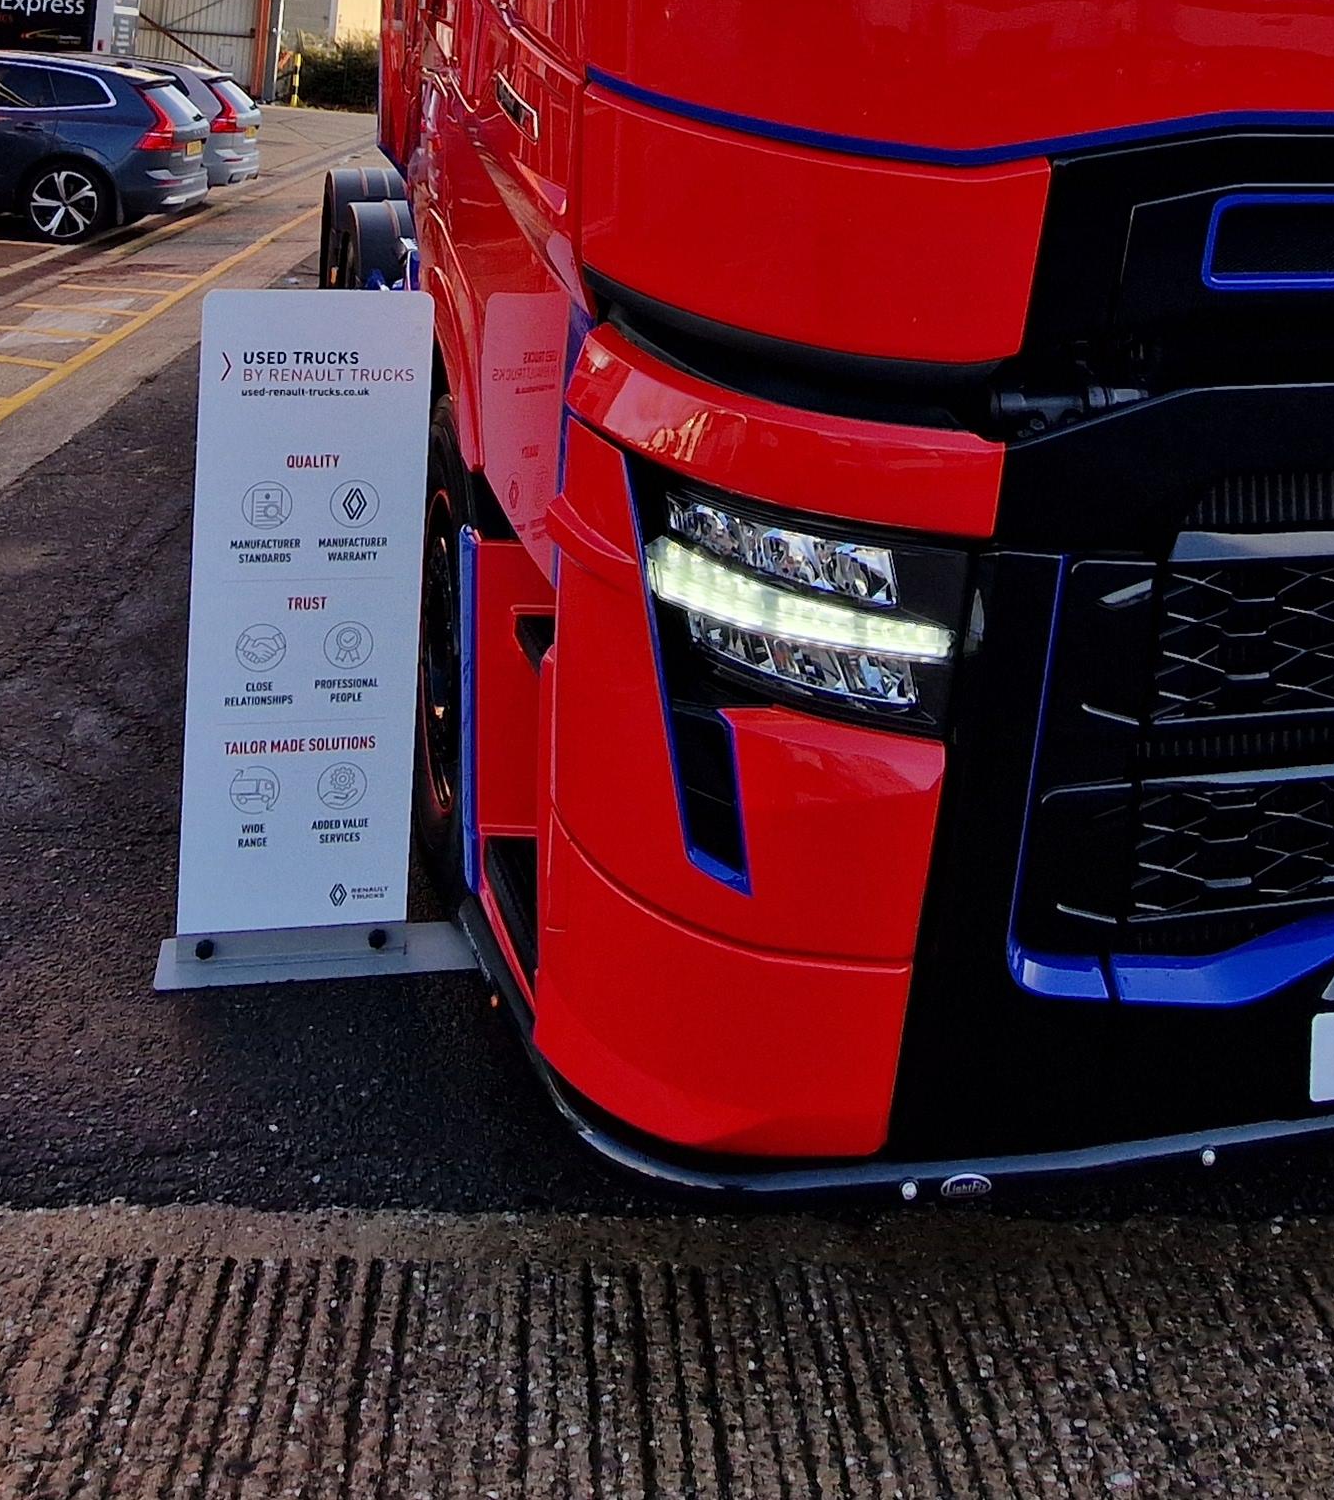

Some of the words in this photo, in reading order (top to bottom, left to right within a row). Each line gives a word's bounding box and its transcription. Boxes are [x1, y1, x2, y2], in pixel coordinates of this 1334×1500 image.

[243, 351, 287, 365] USED
[293, 351, 359, 365] TRUCKS
[243, 368, 264, 382] BY
[269, 368, 345, 382] RENAULT
[351, 368, 415, 382] TRUCKS
[241, 387, 370, 397] used-renault-trucks.co.uk
[286, 454, 340, 469] QUALITY
[230, 538, 301, 550] MANUFACTURER
[318, 537, 388, 548] MANUFACTURER
[238, 553, 292, 564] STANDARDS
[327, 551, 378, 562] WARRANTY
[287, 596, 327, 610] TRUST
[245, 681, 273, 692] CLOSE
[314, 678, 379, 690] PROFESSIONAL
[224, 694, 293, 707] RELATIONSHIPS
[330, 692, 363, 703] PEOPLE
[224, 740, 267, 755] TAILOR
[270, 739, 306, 753] MADE
[308, 735, 376, 751] SOLUTIONS
[241, 823, 266, 834] WIDE
[311, 819, 341, 831] ADDED
[342, 817, 369, 829] VALUE
[237, 836, 267, 849] RANGE
[319, 832, 361, 844] SERVICES
[350, 885, 389, 894] RENAULT
